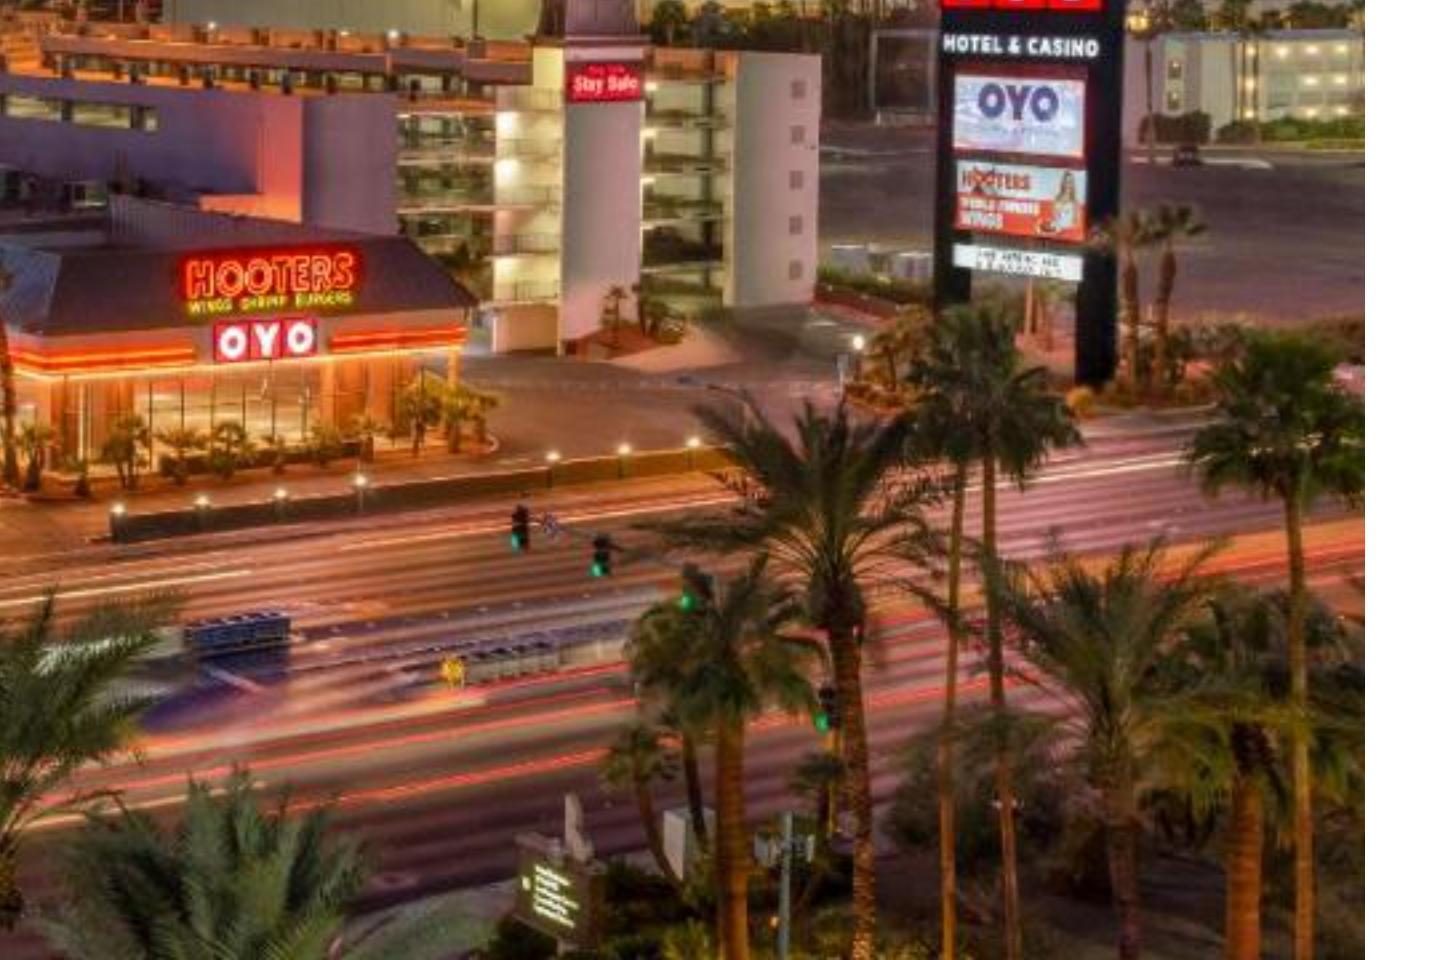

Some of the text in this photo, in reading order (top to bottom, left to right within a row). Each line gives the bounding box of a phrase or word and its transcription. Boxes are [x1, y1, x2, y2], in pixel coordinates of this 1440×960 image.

[943, 34, 1100, 58] HOTEL & CASINO
[977, 82, 1060, 123] OYO
[185, 253, 354, 299] HOOTERS
[188, 297, 233, 314] WINGS
[219, 322, 313, 357] OYO
